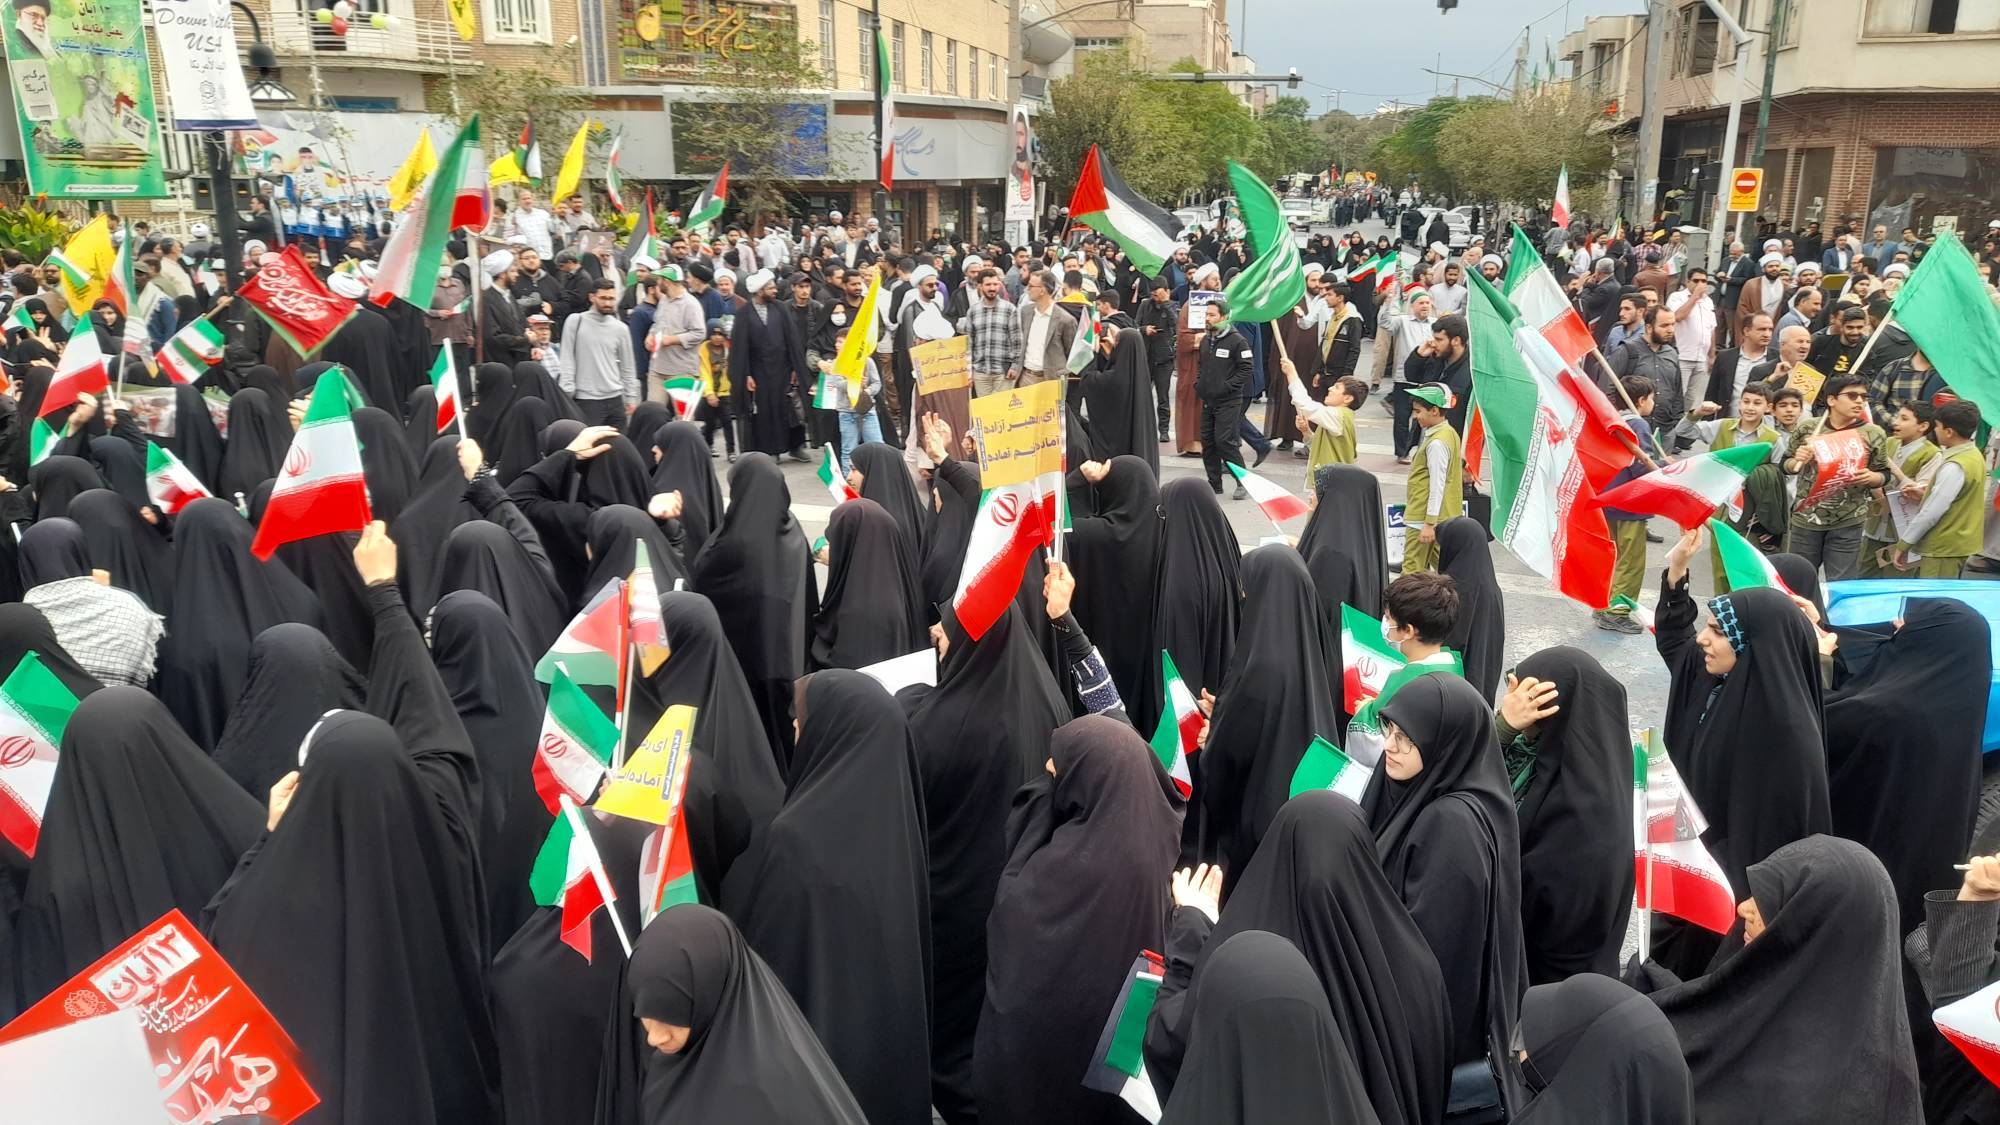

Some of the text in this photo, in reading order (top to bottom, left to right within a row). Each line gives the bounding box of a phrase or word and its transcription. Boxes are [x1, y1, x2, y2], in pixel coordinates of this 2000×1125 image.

[79, 2, 96, 17] آبان
[155, 7, 207, 26] Down
[983, 408, 1055, 434] ای رهبر آزاده
[653, 738, 668, 753] ای
[109, 928, 182, 1003] ۱۳ آبان
